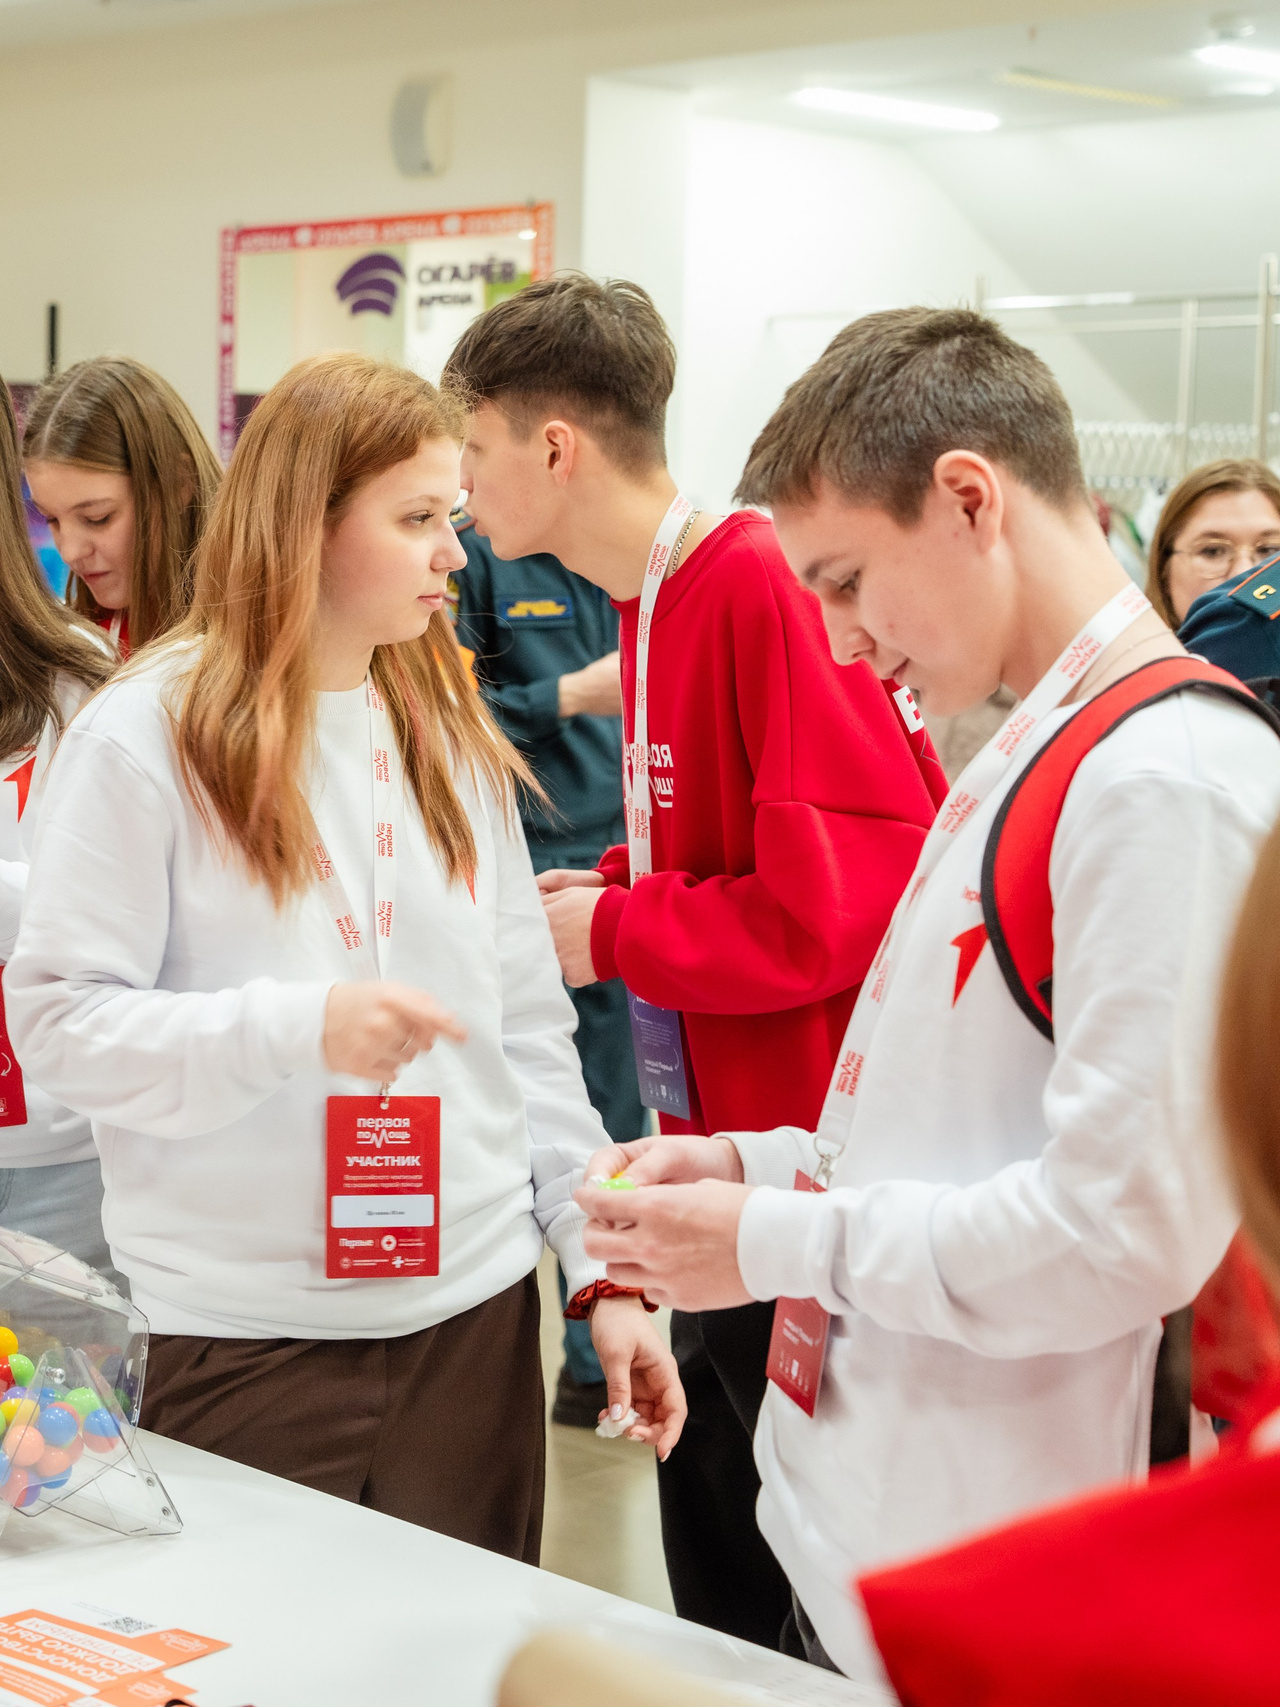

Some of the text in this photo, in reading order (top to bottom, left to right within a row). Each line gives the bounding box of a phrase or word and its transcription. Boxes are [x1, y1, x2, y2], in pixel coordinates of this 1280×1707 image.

[648, 543, 660, 575] первая
[382, 750, 390, 783] первая
[336, 918, 353, 950] первая
[385, 901, 393, 937] первая
[356, 1117, 410, 1131] первая
[345, 1155, 421, 1167] УЧАСТНИК
